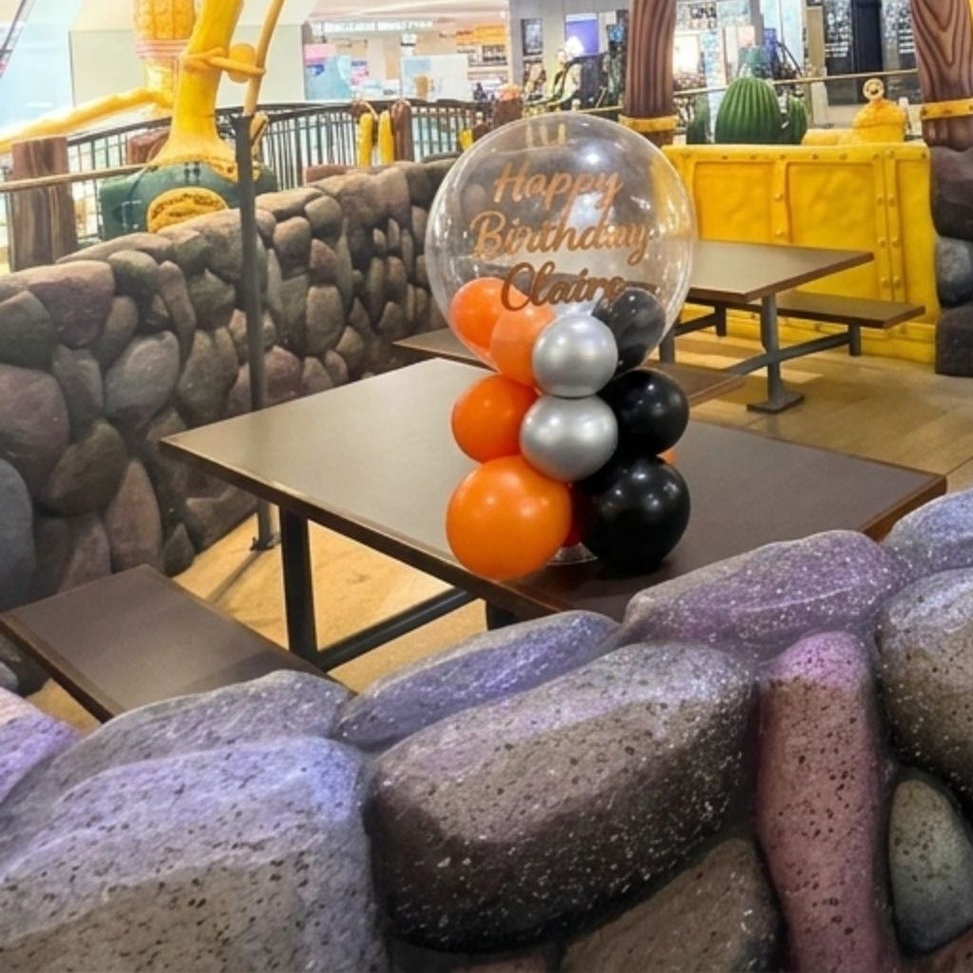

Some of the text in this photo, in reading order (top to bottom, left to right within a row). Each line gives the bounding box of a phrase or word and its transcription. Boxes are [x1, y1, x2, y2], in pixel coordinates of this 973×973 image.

[493, 161, 624, 227] Happy
[469, 211, 652, 266] Birthday
[501, 261, 627, 312] Claire
